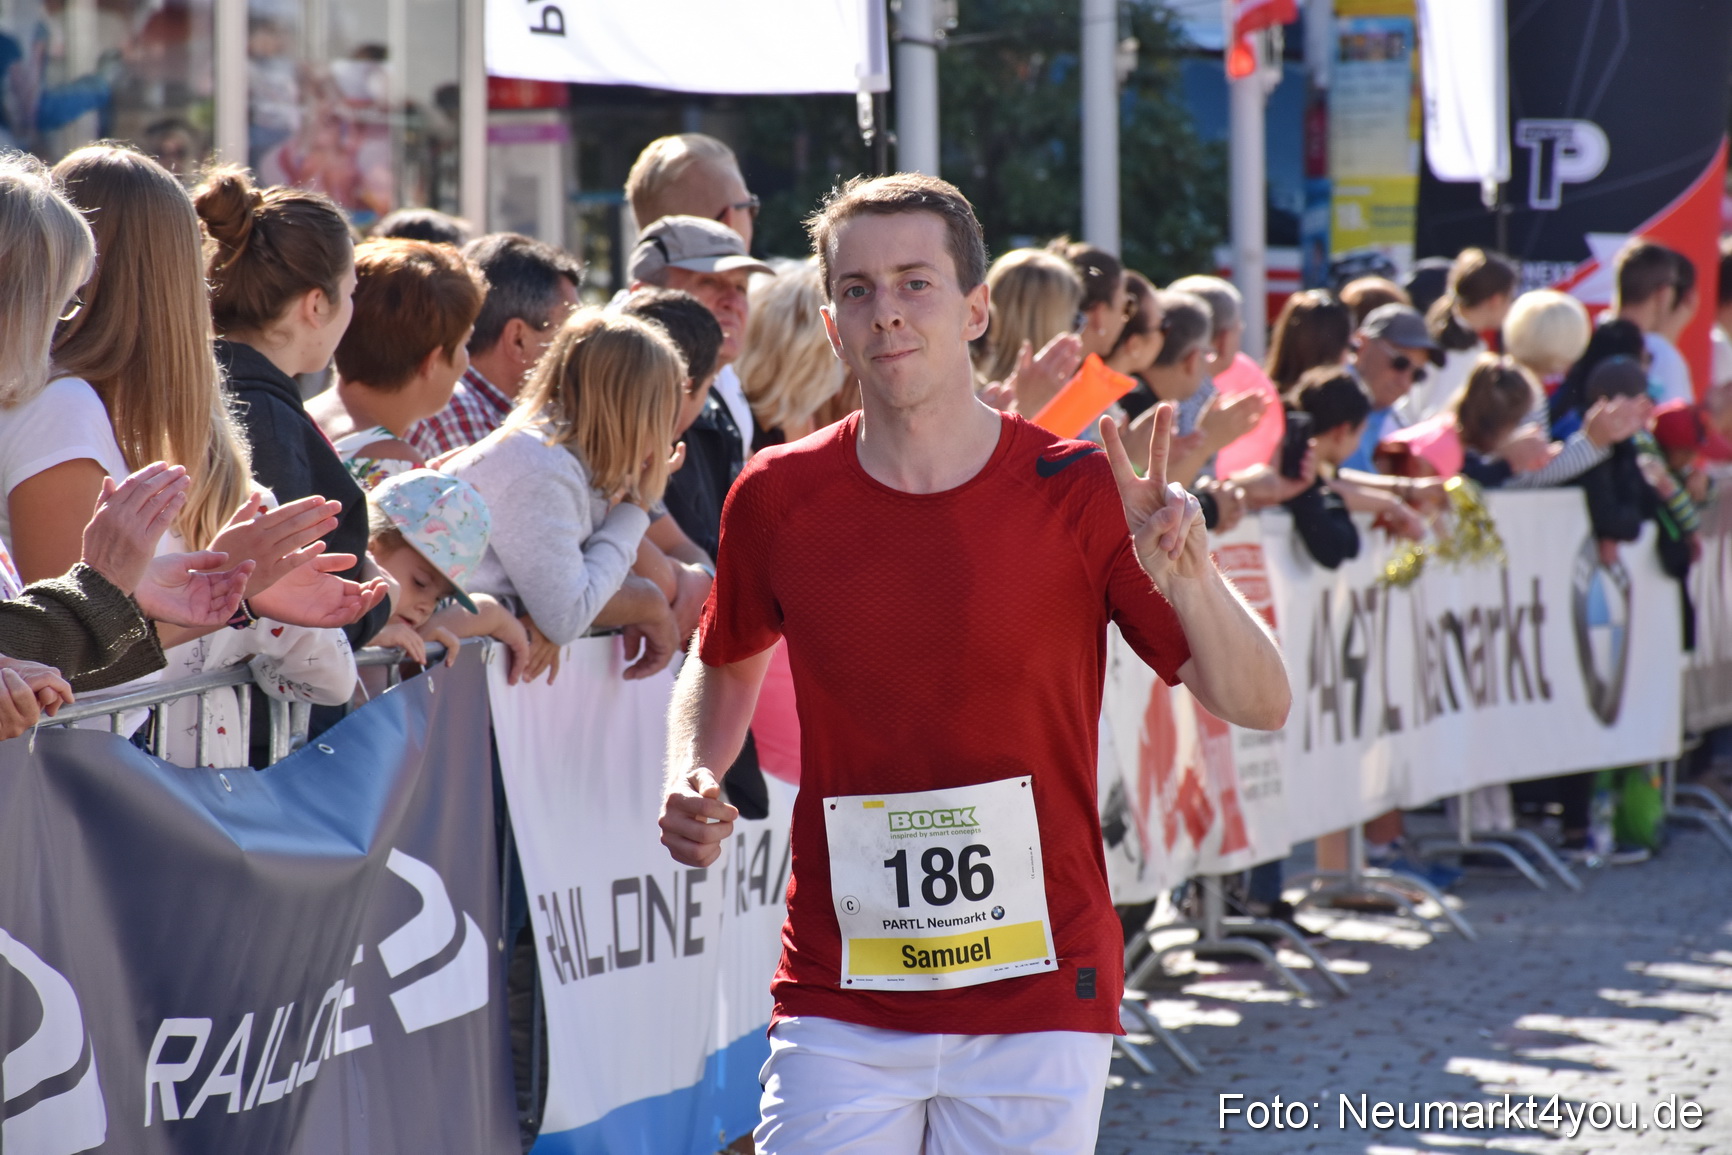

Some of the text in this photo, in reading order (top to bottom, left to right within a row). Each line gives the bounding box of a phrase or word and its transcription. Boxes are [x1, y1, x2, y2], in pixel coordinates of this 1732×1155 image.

[888, 806, 980, 832] BOCK
[890, 832, 918, 840] inspired
[929, 829, 949, 837] smart
[951, 828, 981, 836] concepts
[884, 844, 994, 908] 186
[846, 900, 854, 911] C
[882, 911, 987, 930] PARTL Neumarkt
[901, 936, 991, 968] Samuel
[144, 944, 373, 1127] RAIL.OE
